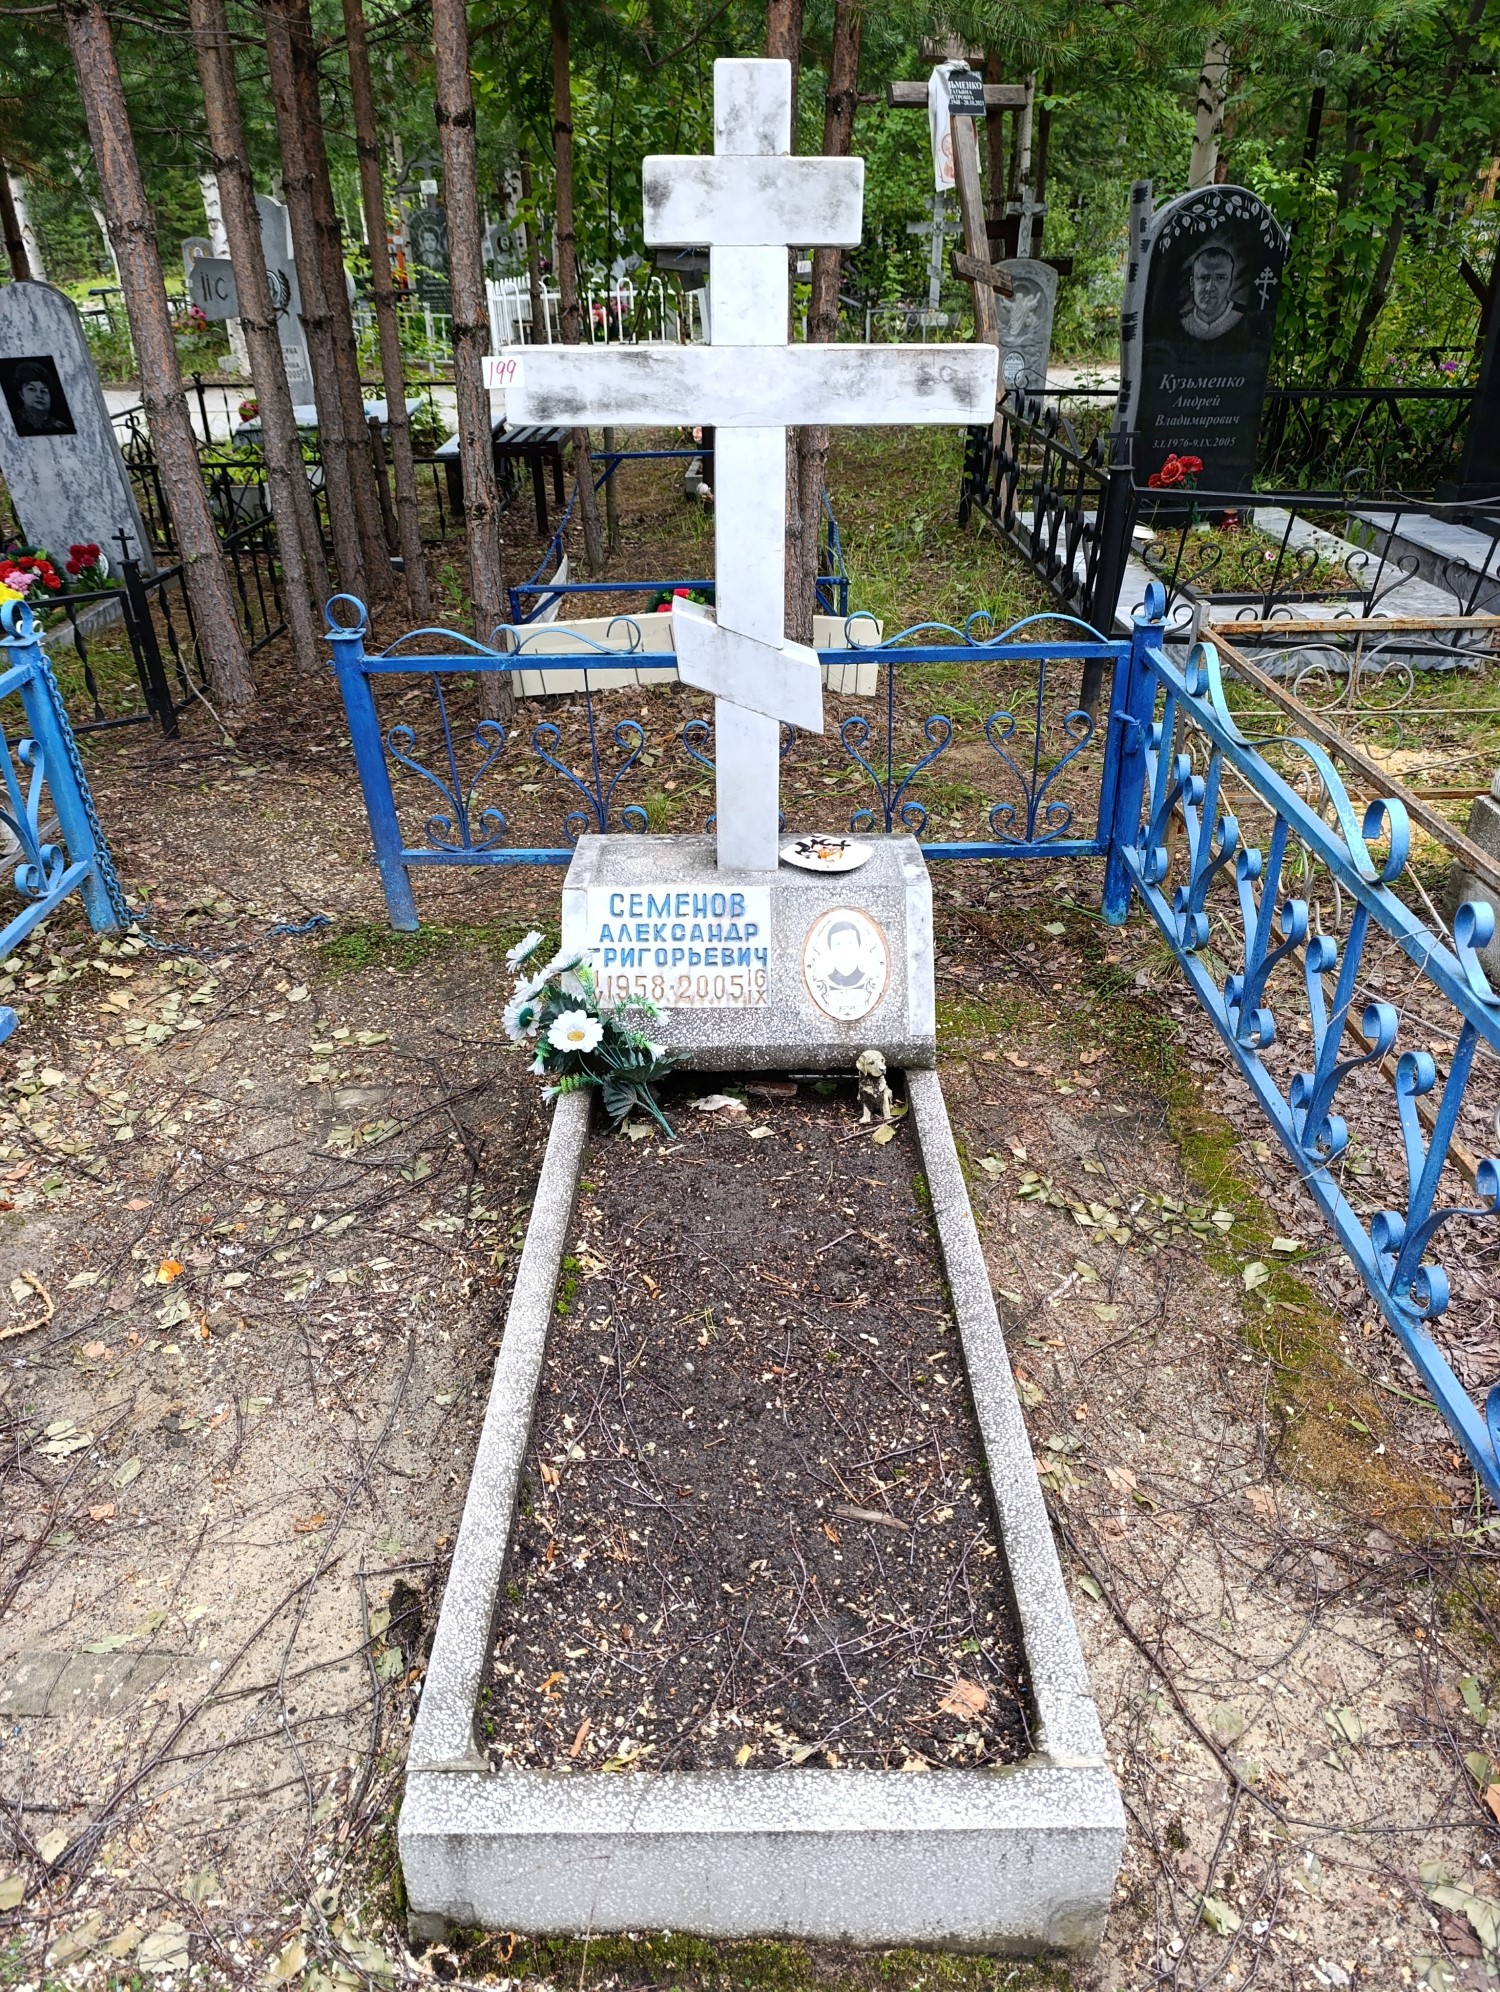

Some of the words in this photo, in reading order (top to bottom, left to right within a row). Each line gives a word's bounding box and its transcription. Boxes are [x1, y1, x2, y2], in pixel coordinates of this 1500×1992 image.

[490, 359, 517, 386] 199
[1159, 373, 1246, 394] Кузьменко
[1172, 394, 1222, 410] Андрей
[1155, 413, 1241, 428] Владимирович
[609, 892, 746, 919] СЕМЕНОВ
[598, 922, 760, 944] АЛЕКСАНДР
